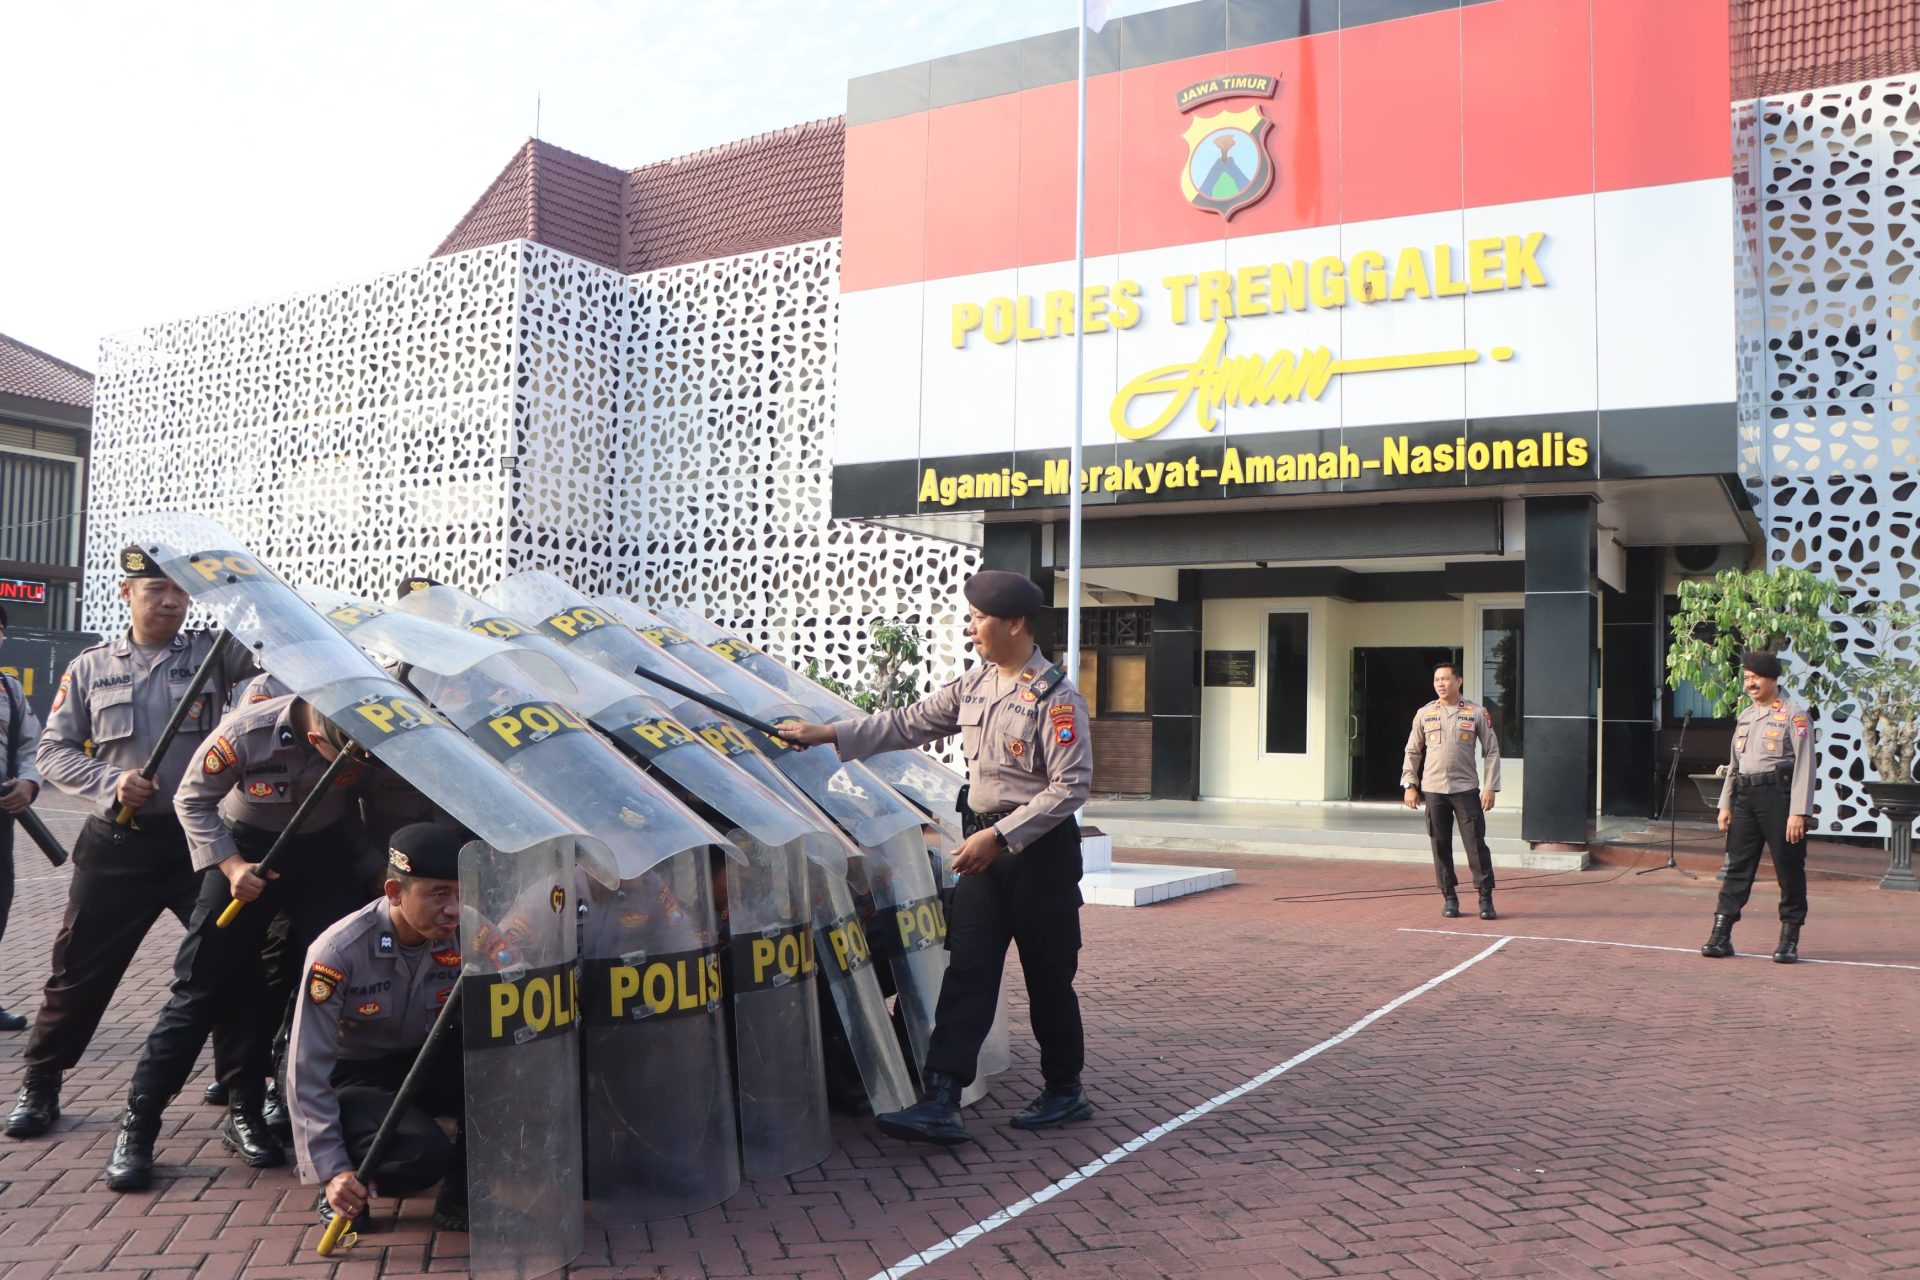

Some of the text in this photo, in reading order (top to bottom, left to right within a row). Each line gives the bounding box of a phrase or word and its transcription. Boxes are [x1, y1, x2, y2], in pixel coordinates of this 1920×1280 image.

[1181, 77, 1267, 103] JAWA TIMUR
[951, 232, 1547, 349] POLRES TRENGGALEK
[1110, 318, 1477, 440] Aman
[490, 969, 579, 1038] POLI
